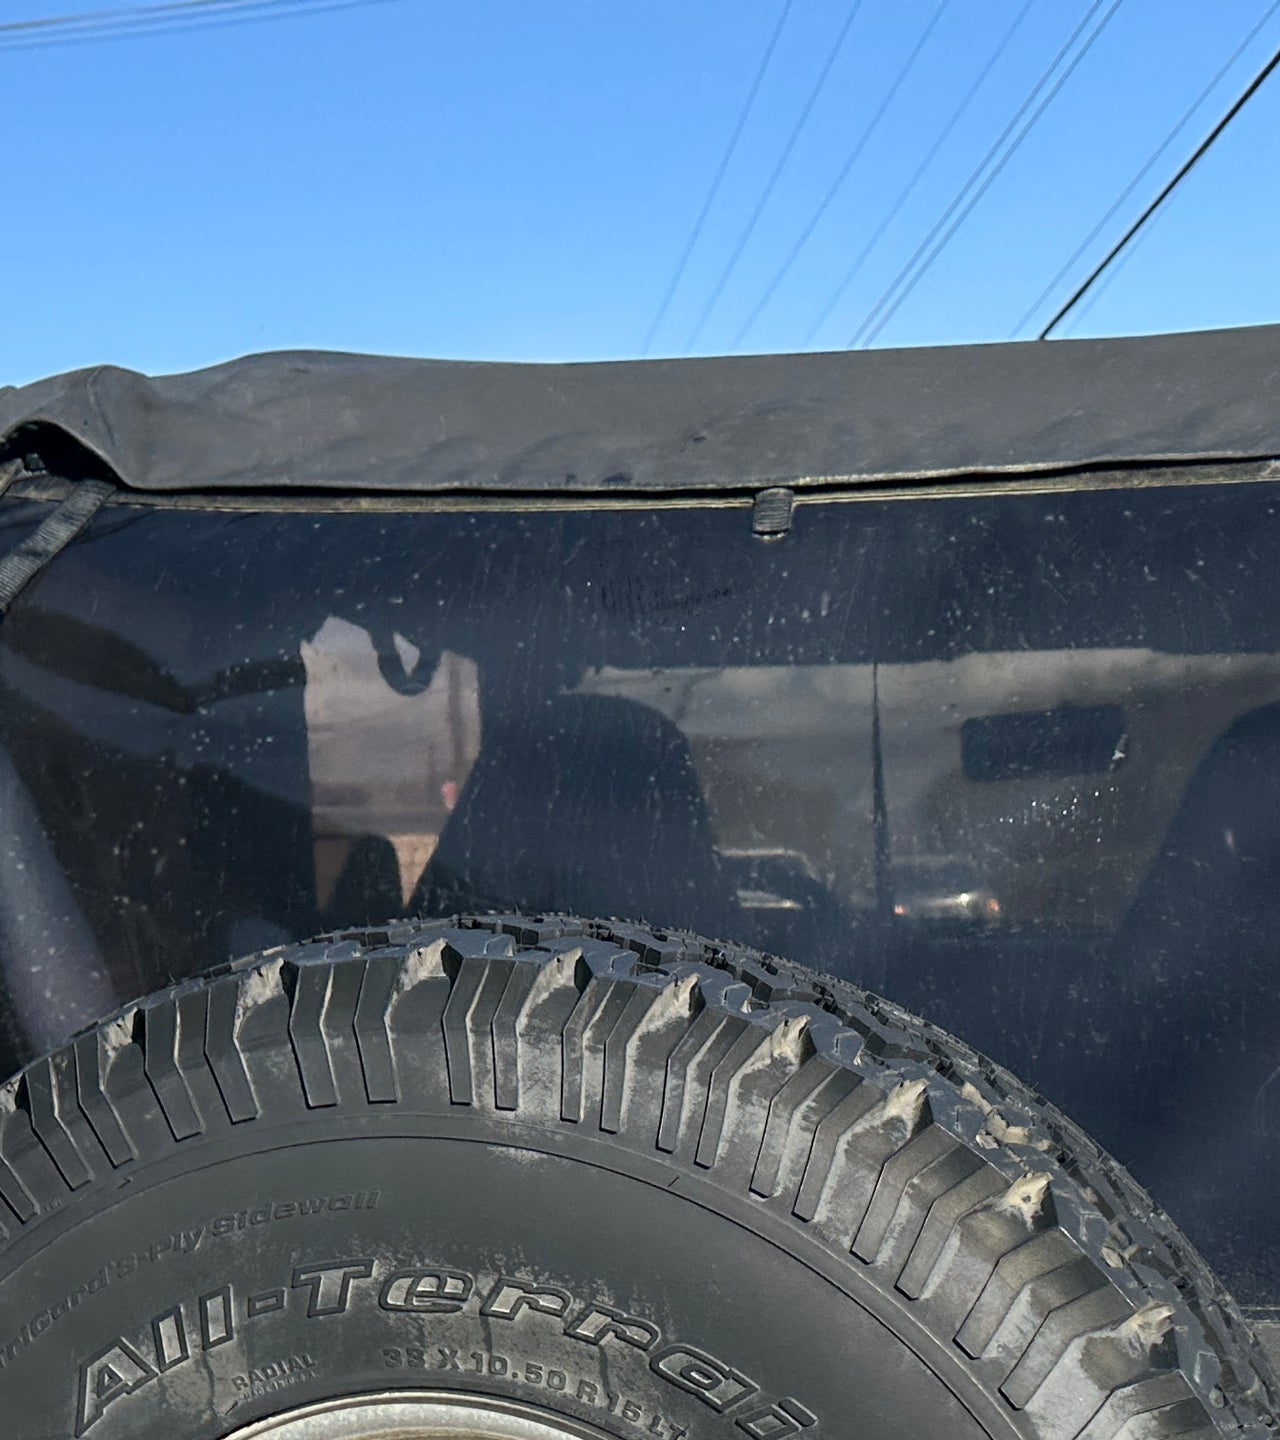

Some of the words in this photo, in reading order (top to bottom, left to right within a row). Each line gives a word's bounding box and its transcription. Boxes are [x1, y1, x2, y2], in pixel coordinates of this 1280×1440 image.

[212, 1190, 381, 1236] Sidewall
[231, 1353, 318, 1391] RADIAL
[381, 1344, 423, 1368] 33
[471, 1351, 567, 1390] 10.50
